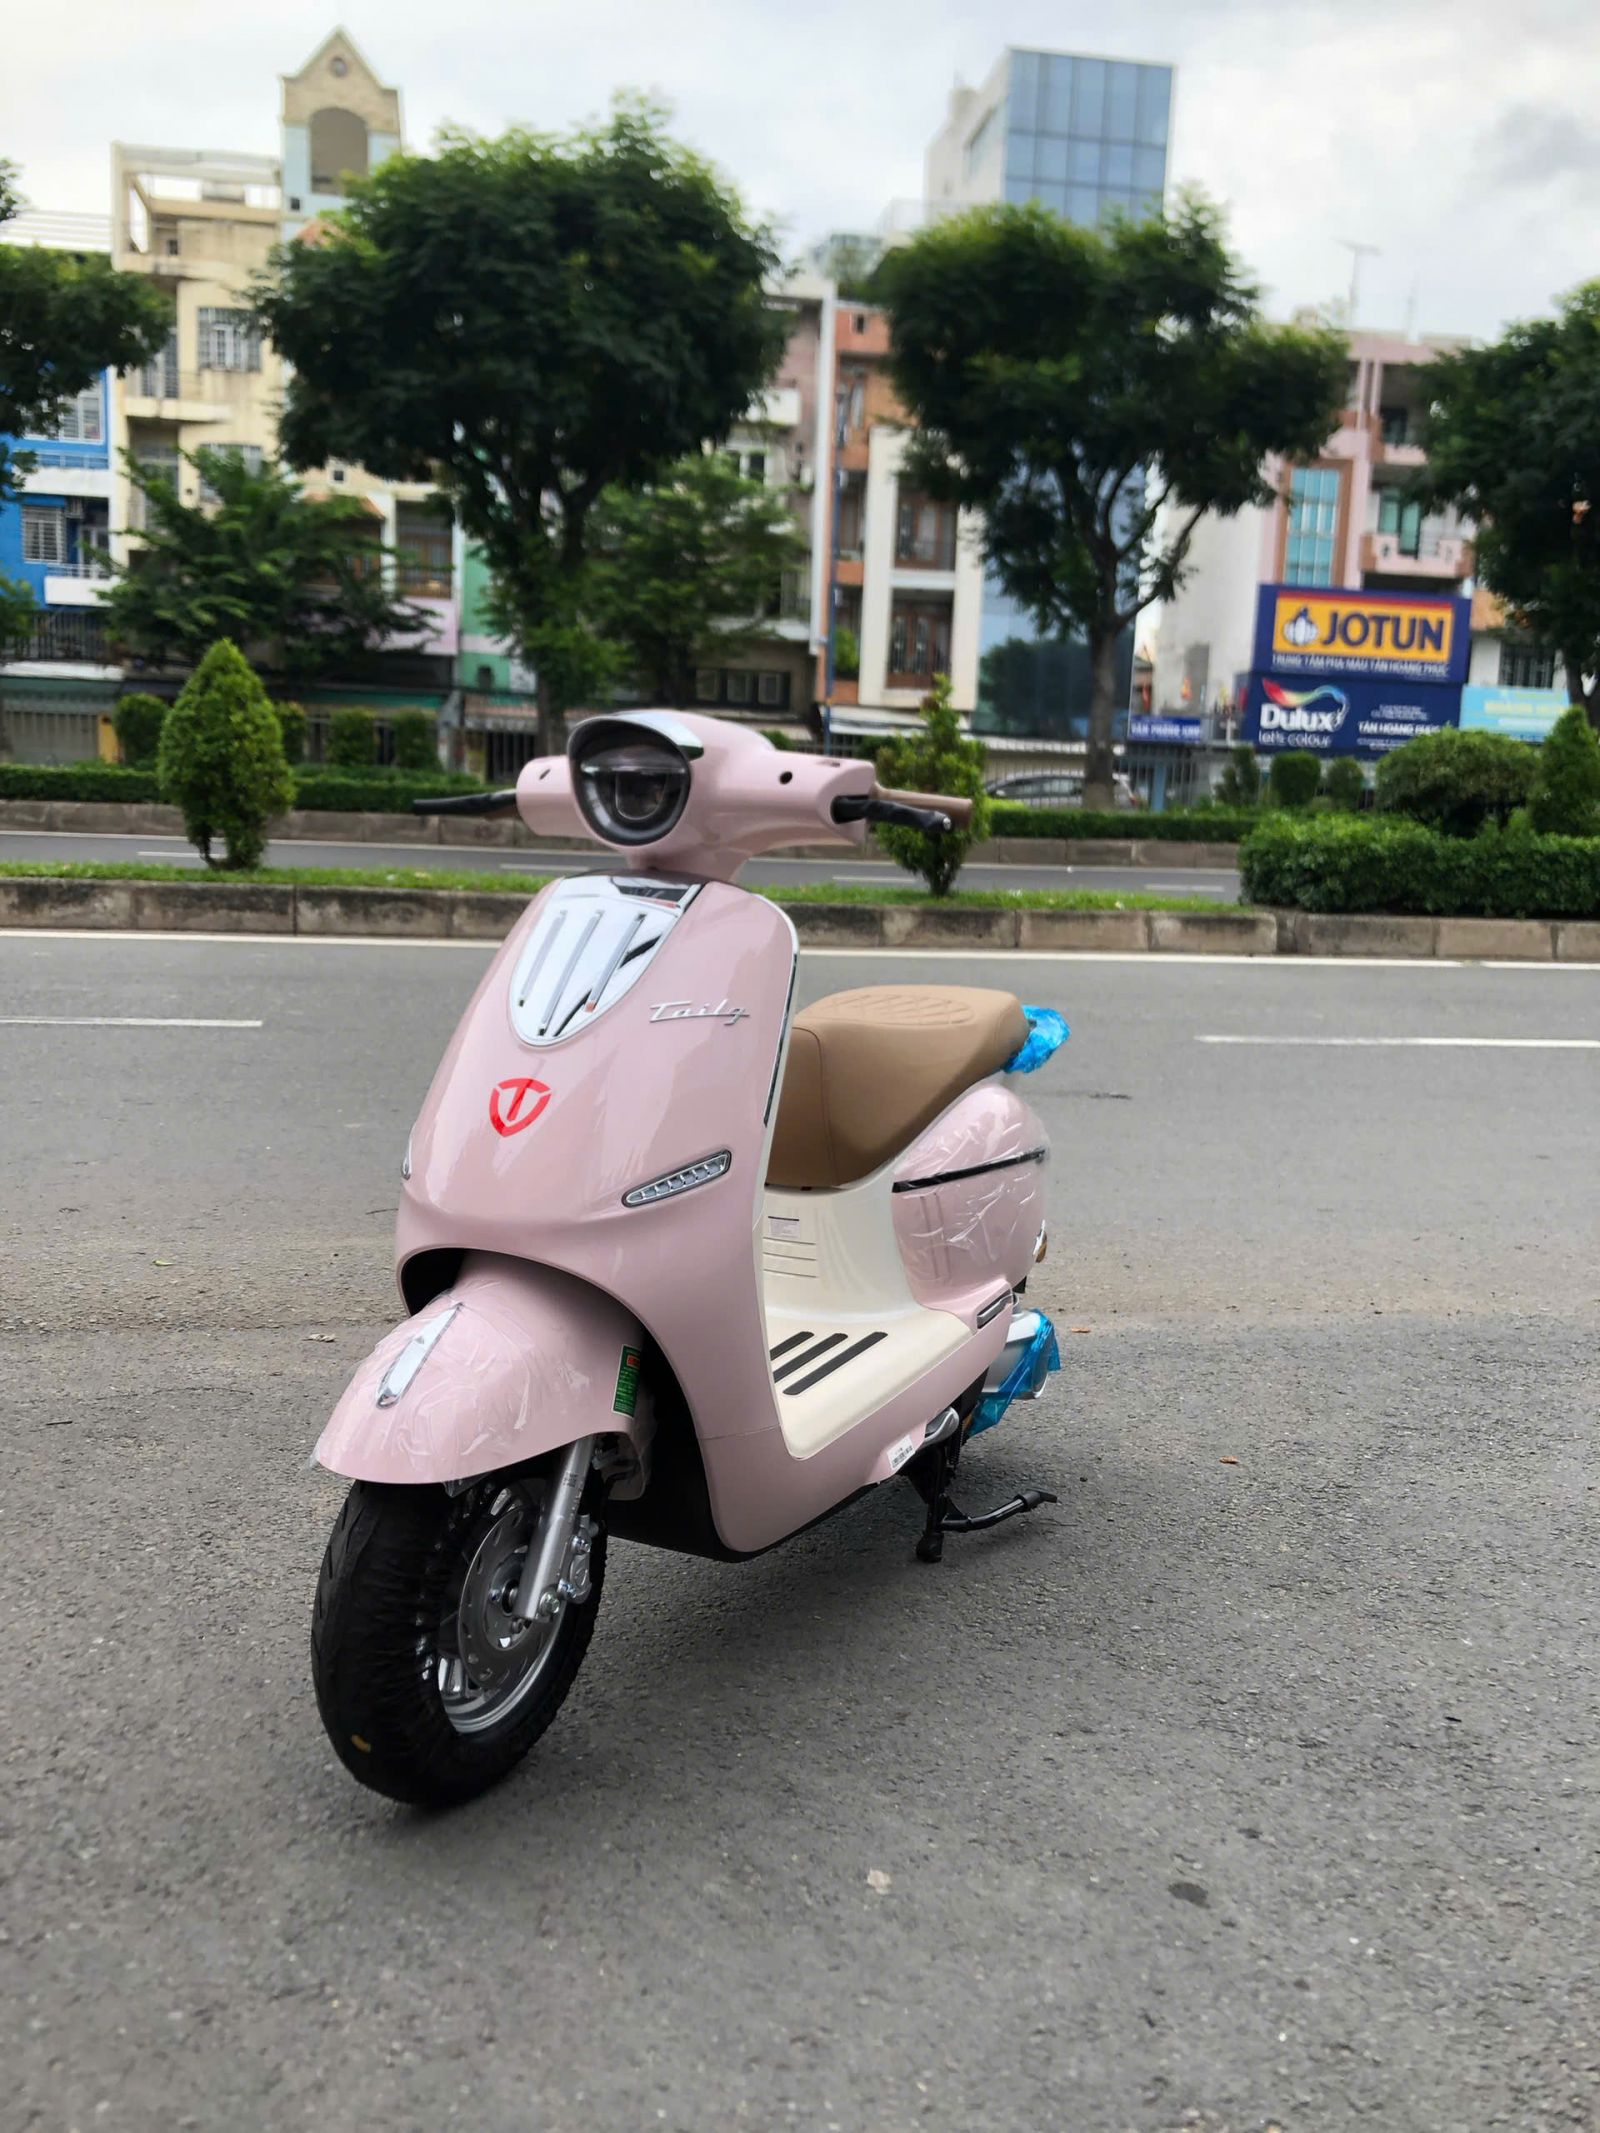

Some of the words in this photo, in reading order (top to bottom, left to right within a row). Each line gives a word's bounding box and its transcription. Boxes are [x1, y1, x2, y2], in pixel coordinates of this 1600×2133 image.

[1321, 611, 1444, 651] JOTUN
[1260, 703, 1333, 732] Dulux
[1288, 731, 1330, 748] colour
[649, 998, 750, 1026] Tailg
